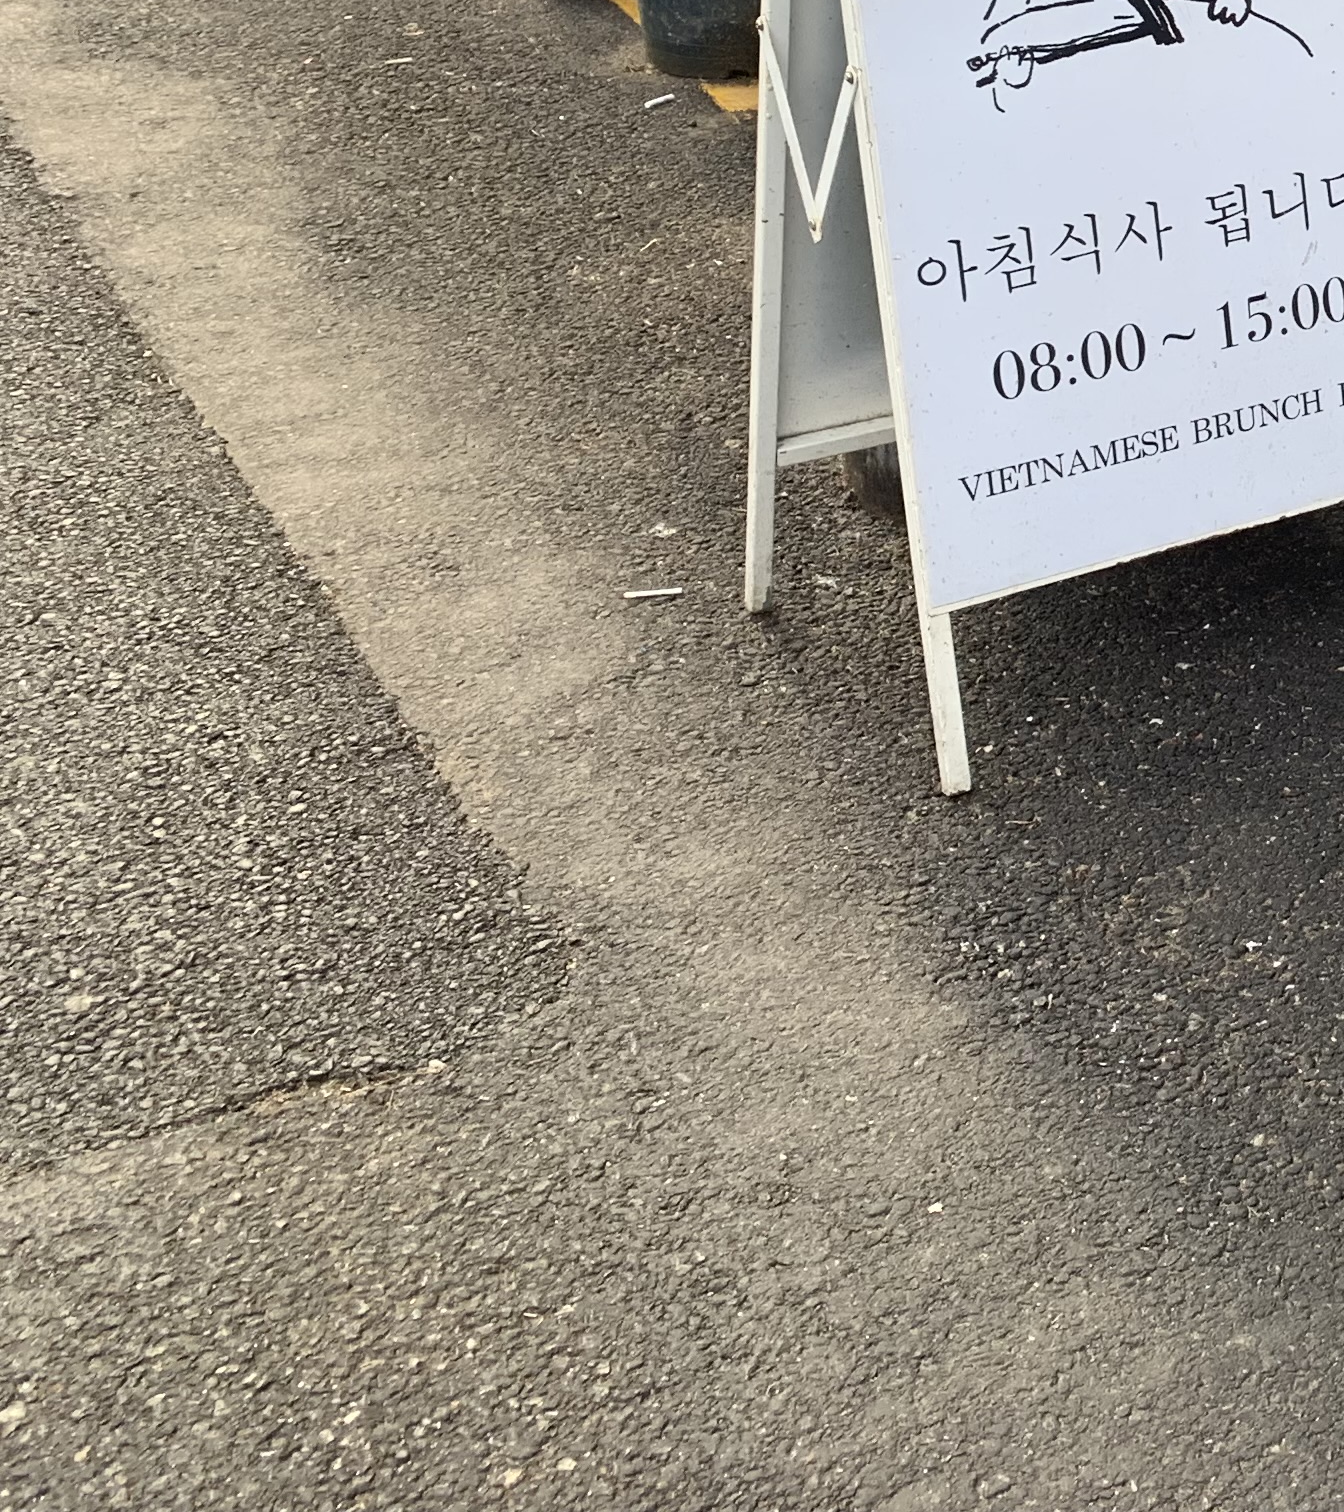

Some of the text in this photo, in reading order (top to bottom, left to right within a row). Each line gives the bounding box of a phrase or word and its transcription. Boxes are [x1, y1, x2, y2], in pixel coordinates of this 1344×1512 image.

[918, 202, 1172, 302] 아침식사
[994, 324, 1146, 399] 08:00
[958, 426, 1179, 500] VIETNAMESE
[1191, 390, 1323, 444] BRUNCH
